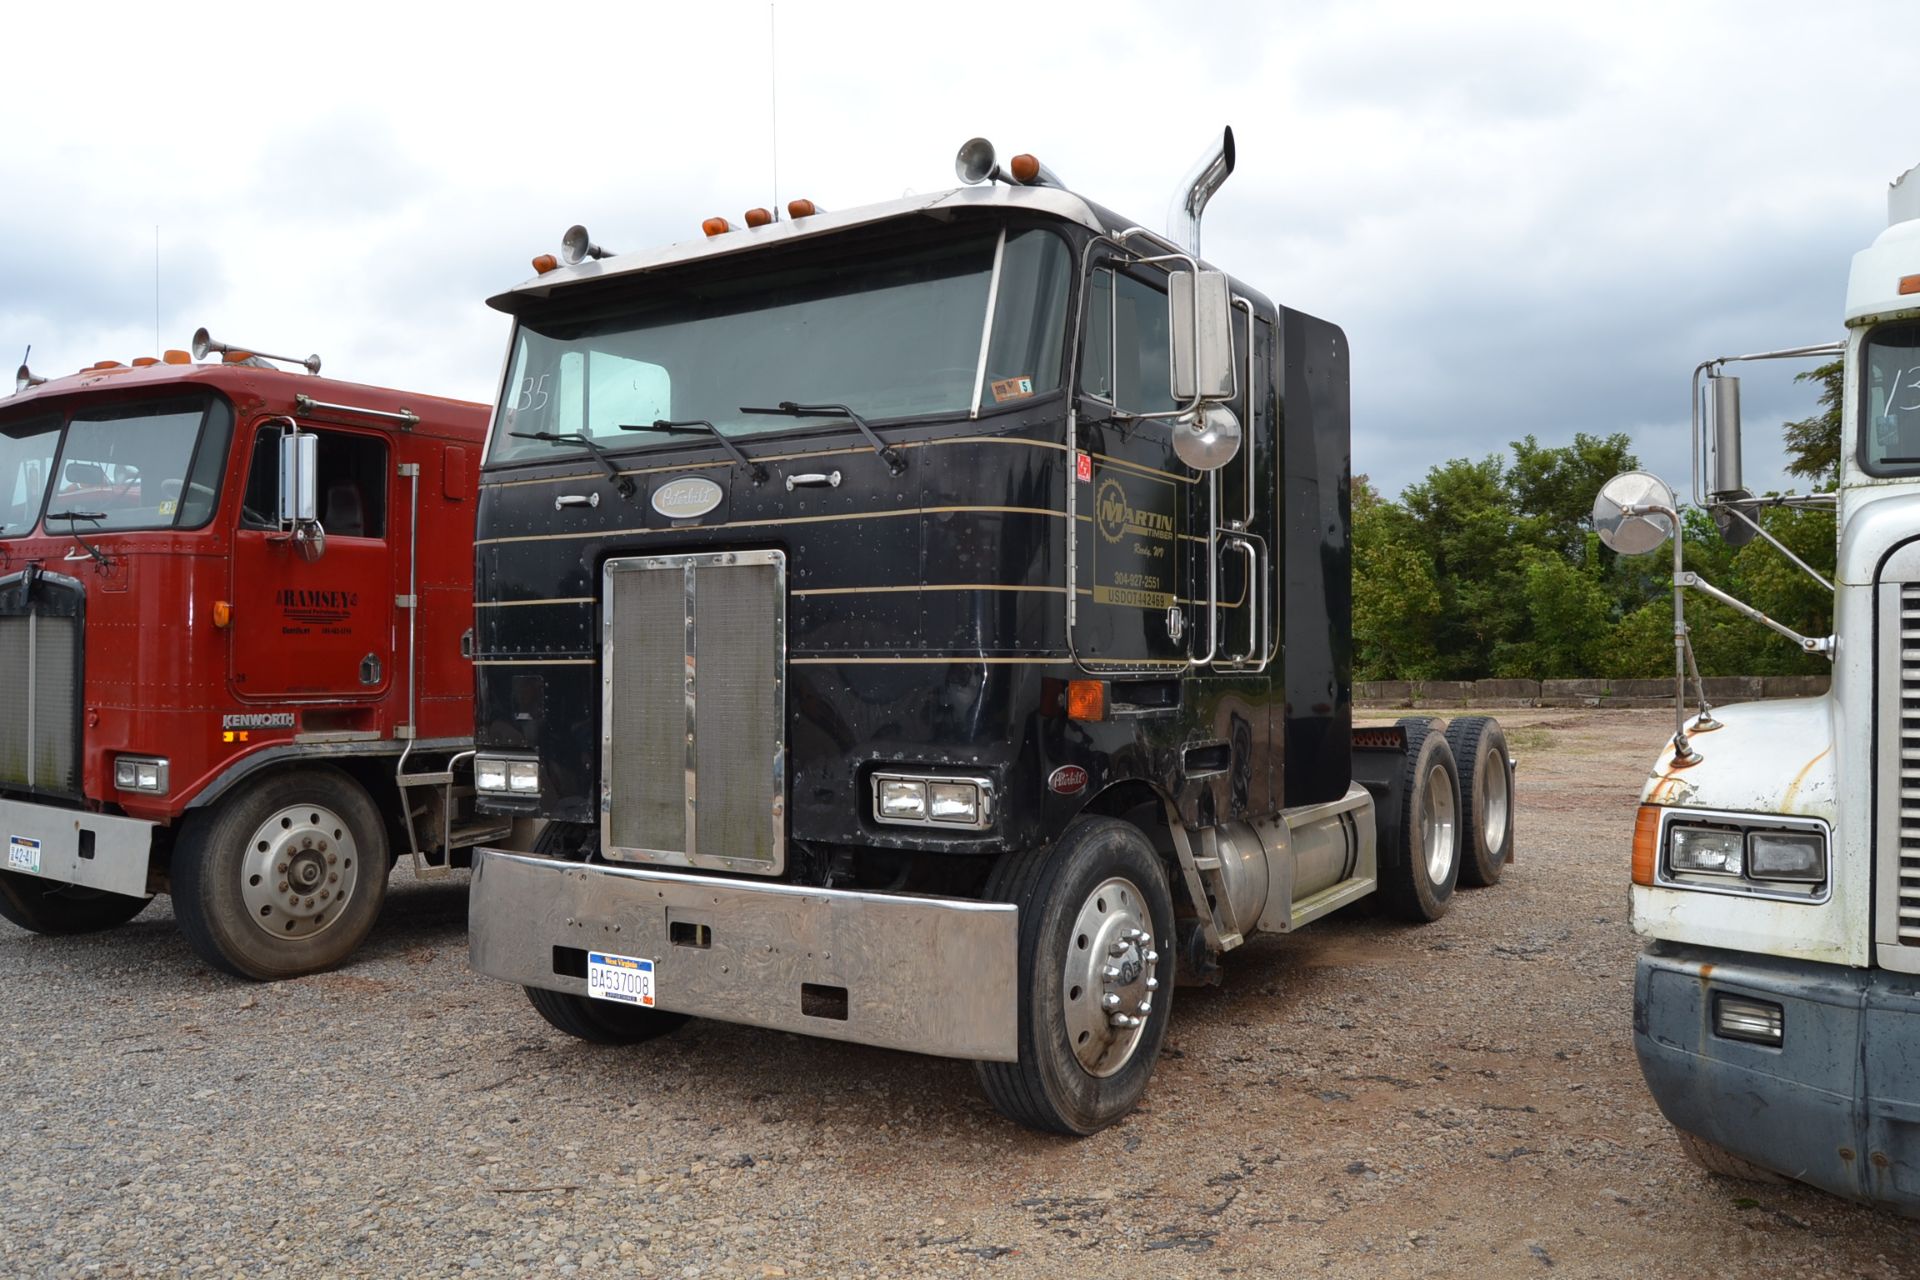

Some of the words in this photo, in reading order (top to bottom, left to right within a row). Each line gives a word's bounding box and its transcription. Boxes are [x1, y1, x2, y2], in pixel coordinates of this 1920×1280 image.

[1101, 499, 1174, 531] MARTIN
[1147, 528, 1174, 540] TIMBER
[222, 712, 295, 727] KENWORTH
[591, 967, 650, 996] BA537008
